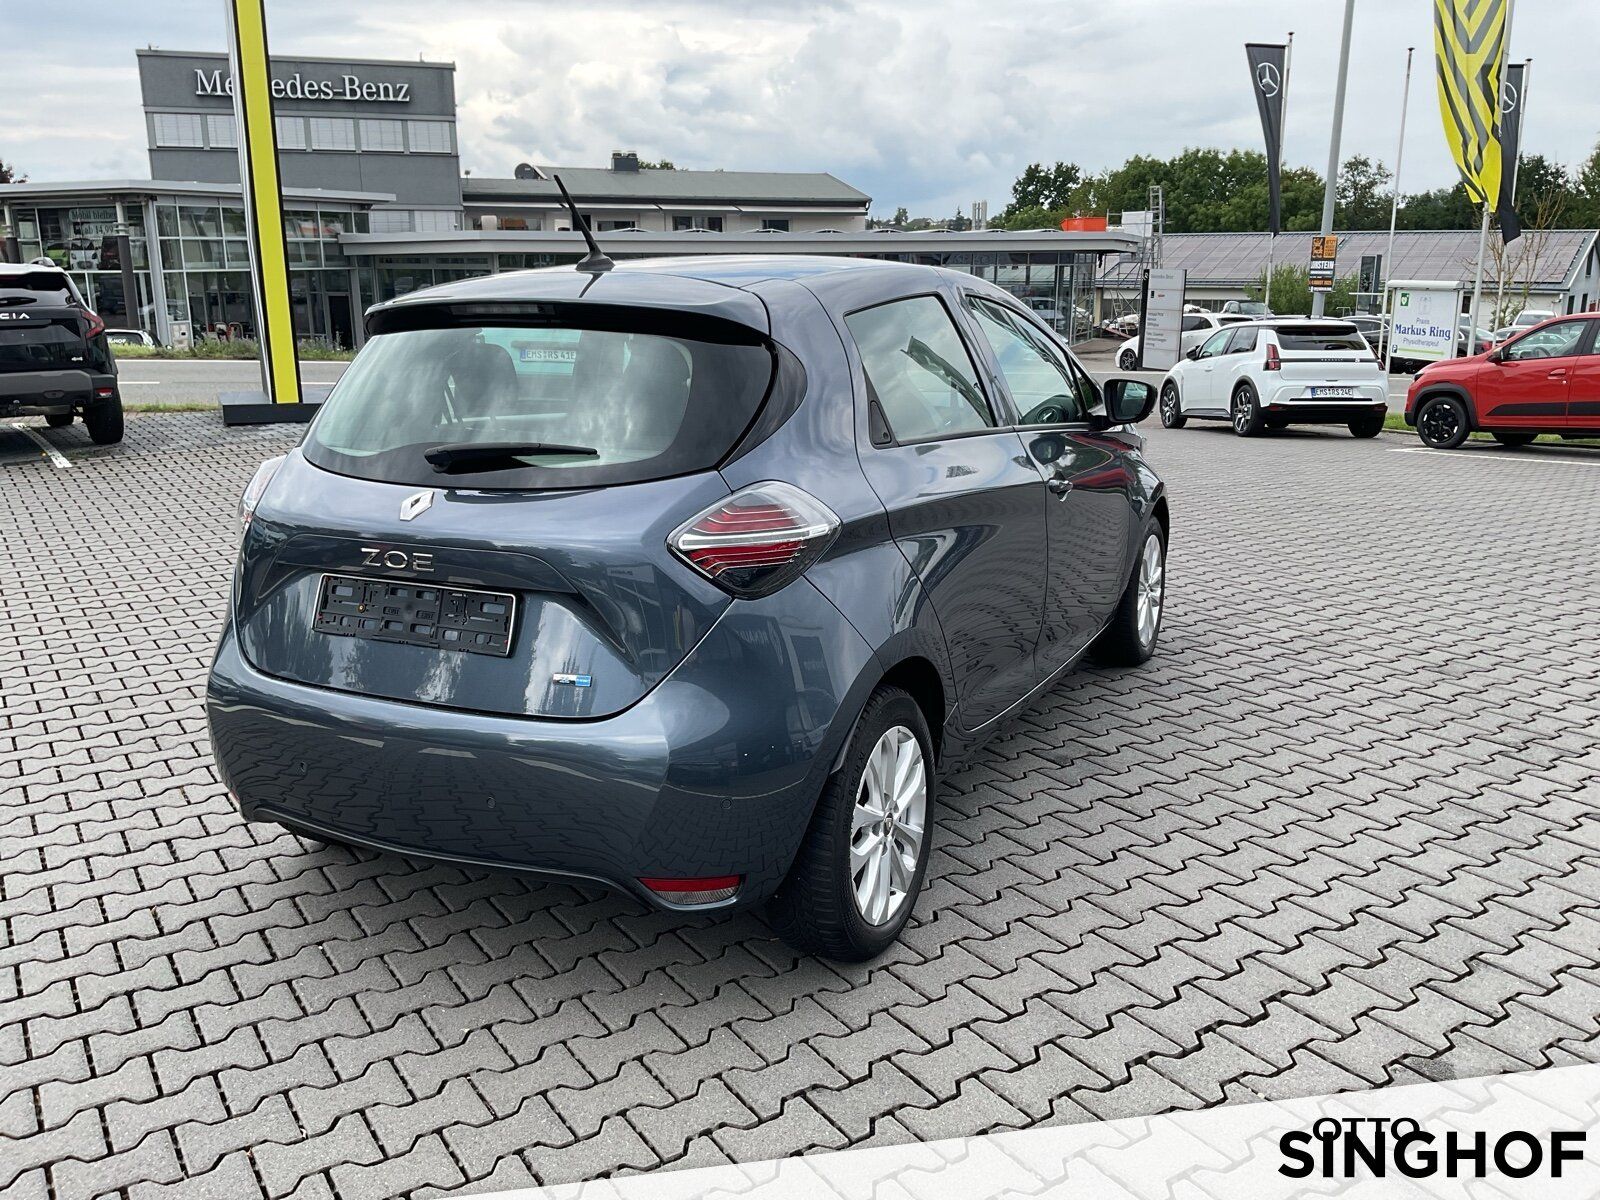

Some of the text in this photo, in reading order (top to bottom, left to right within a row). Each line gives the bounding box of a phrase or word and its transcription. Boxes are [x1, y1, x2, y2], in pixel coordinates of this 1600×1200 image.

[195, 69, 409, 101] Meedes-Benz
[1394, 323, 1451, 341] Markus Ring
[1402, 337, 1440, 347] Physiotherapeut
[547, 350, 559, 360] RS
[1331, 388, 1340, 396] RS
[360, 547, 435, 572] ZOE
